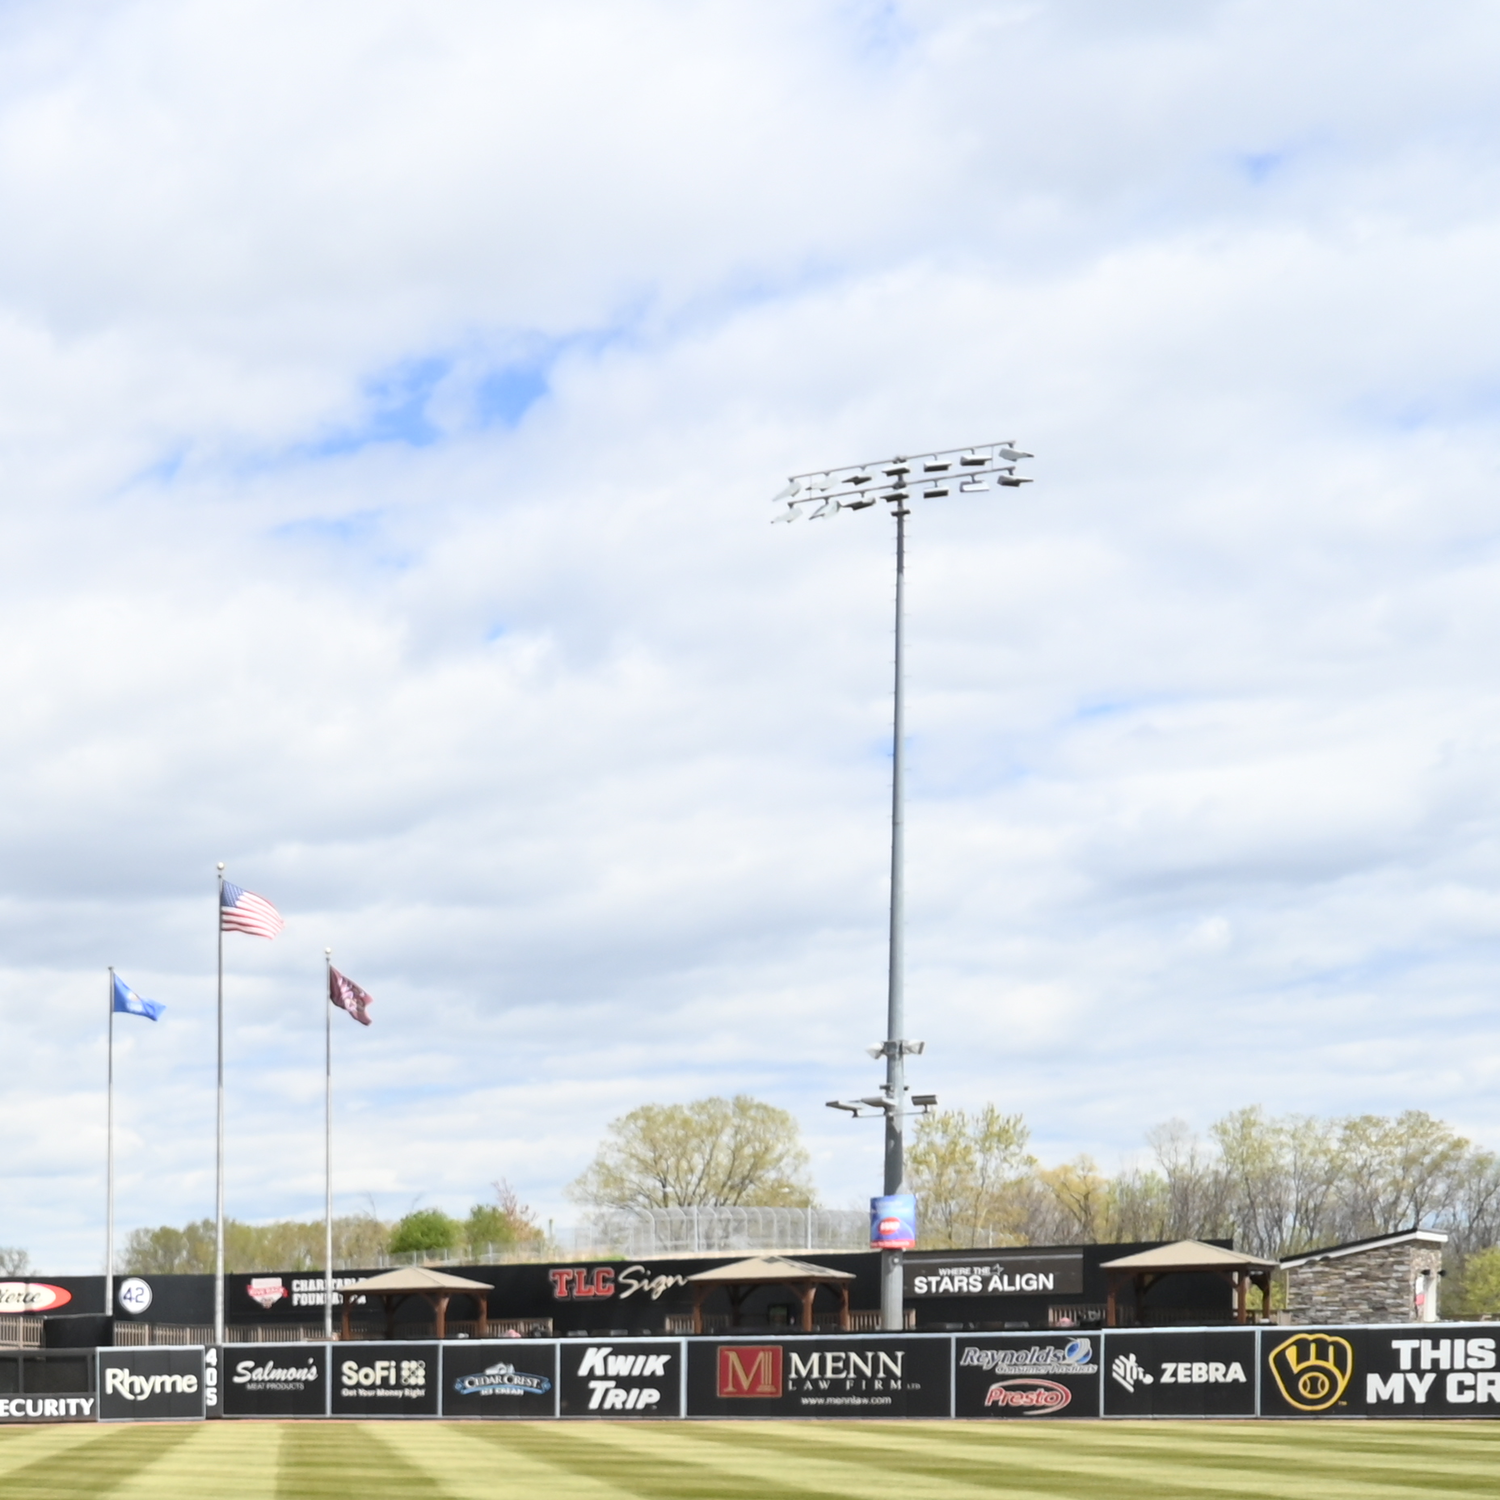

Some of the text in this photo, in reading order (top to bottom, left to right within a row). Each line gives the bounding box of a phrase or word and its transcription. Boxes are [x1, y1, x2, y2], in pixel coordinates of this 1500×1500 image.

[939, 1266, 991, 1276] WHERE THE
[550, 1265, 689, 1300] TLC Sign
[914, 1273, 1054, 1294] STARS ALIGN
[123, 1287, 146, 1303] 42
[577, 1347, 672, 1377] KWIK
[788, 1351, 905, 1380] MENN
[960, 1347, 1066, 1369] Reynolds
[1391, 1338, 1496, 1371] THIS
[233, 1358, 318, 1384] Salmon's
[341, 1360, 396, 1386] SoFi
[996, 1363, 1098, 1375] Consumer Products
[1160, 1362, 1247, 1384] ZEBRA
[105, 1368, 198, 1400] Rhyme
[247, 1382, 304, 1390] MEAT PRODUCTS
[465, 1374, 541, 1388] CEDAR CREST
[788, 1380, 831, 1391] LAW
[846, 1379, 903, 1391] FIRM
[1366, 1372, 1437, 1404] MY
[359, 1388, 375, 1397] Your
[376, 1388, 403, 1398] Money
[404, 1388, 426, 1398] Right
[588, 1380, 661, 1410] TRIP
[801, 1395, 892, 1405] www.mennlaw.com
[985, 1387, 1061, 1407] Presto
